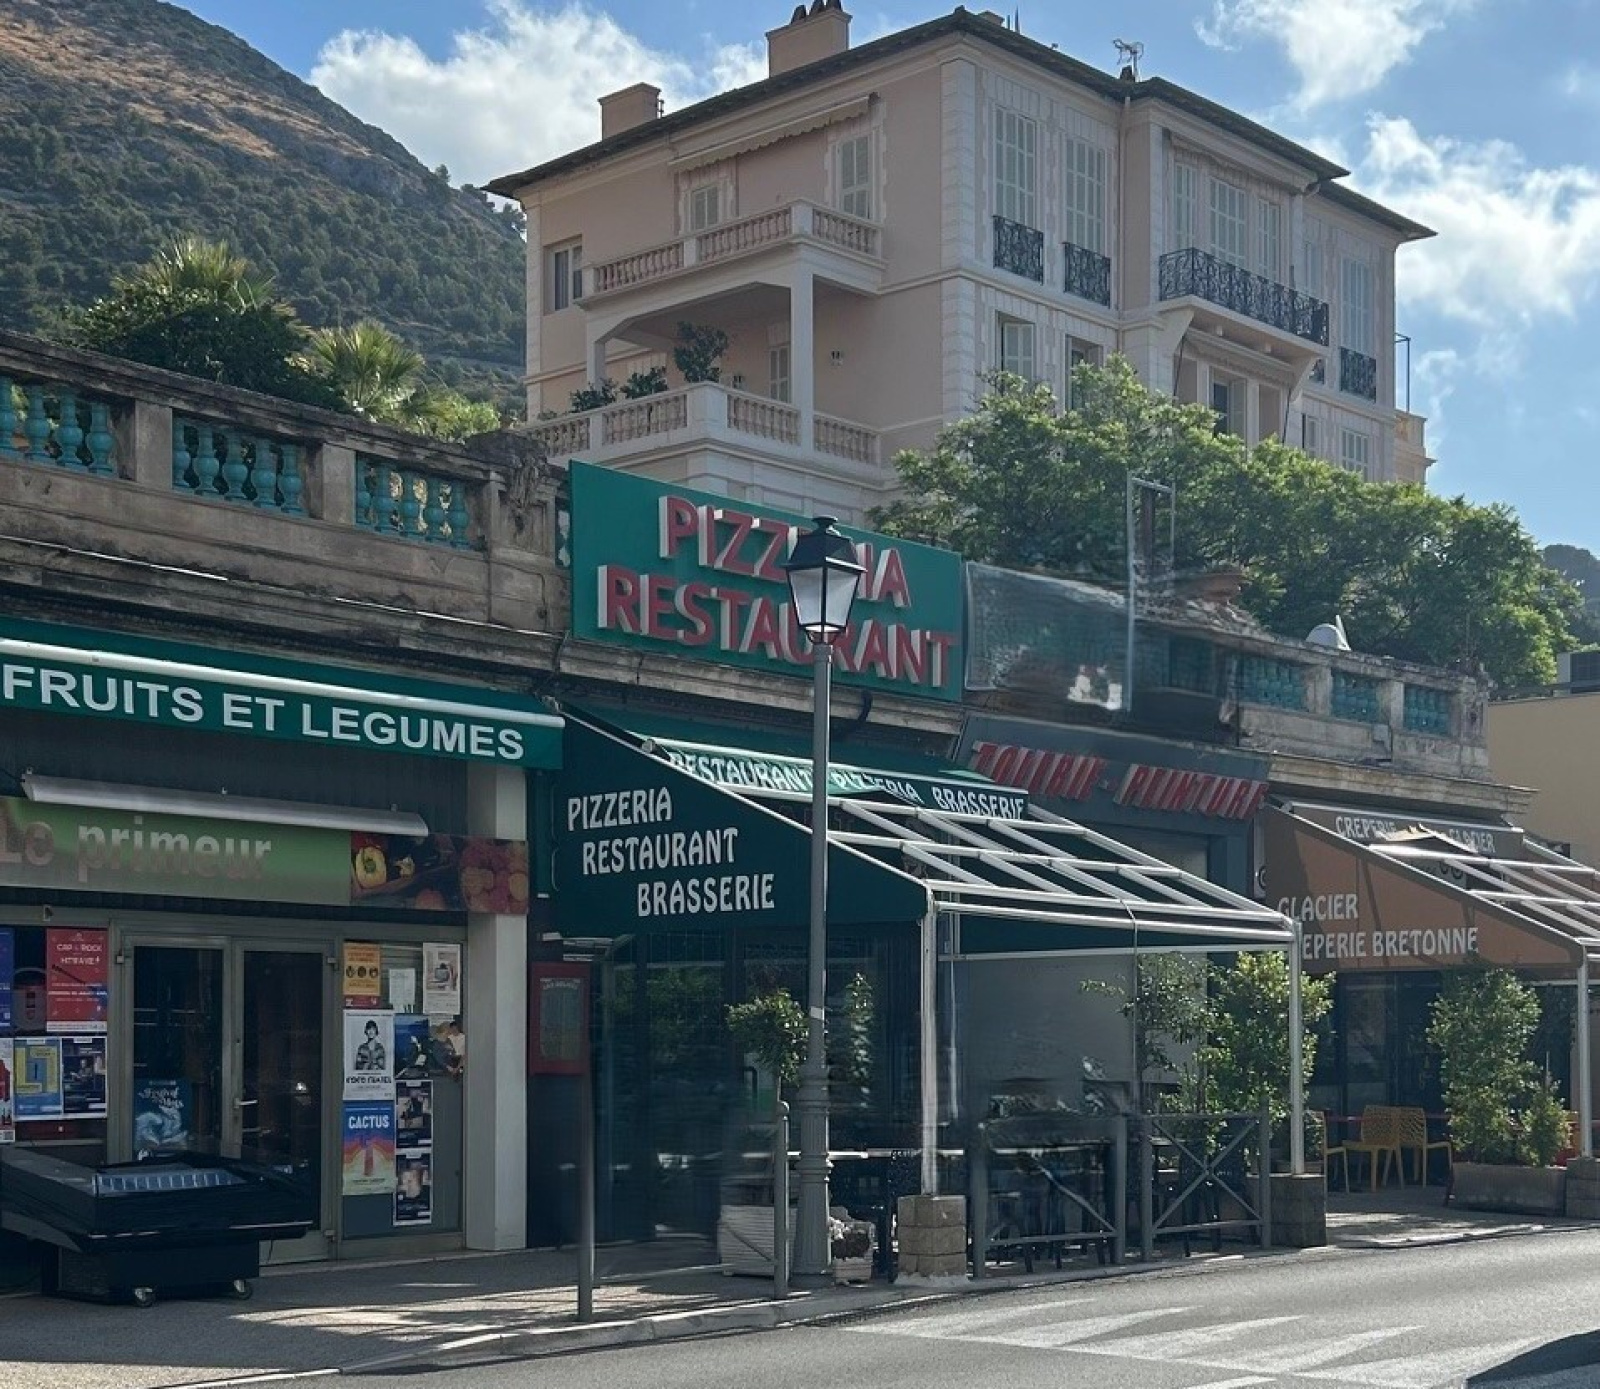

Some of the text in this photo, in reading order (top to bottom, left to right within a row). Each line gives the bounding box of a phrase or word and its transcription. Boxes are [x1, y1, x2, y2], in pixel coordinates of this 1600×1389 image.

[658, 495, 911, 608] PIZZIA
[3, 663, 525, 760] FRUITS ET LEGUMES
[567, 786, 673, 831] PIZZERIA
[77, 814, 272, 882] primeur
[582, 826, 739, 875] RESTAURANT
[637, 873, 775, 917] BRASSERIE
[1278, 893, 1359, 921] GLACIER
[1302, 927, 1479, 960] EPERIE BRETONNE
[348, 1114, 390, 1129] CACTUS
